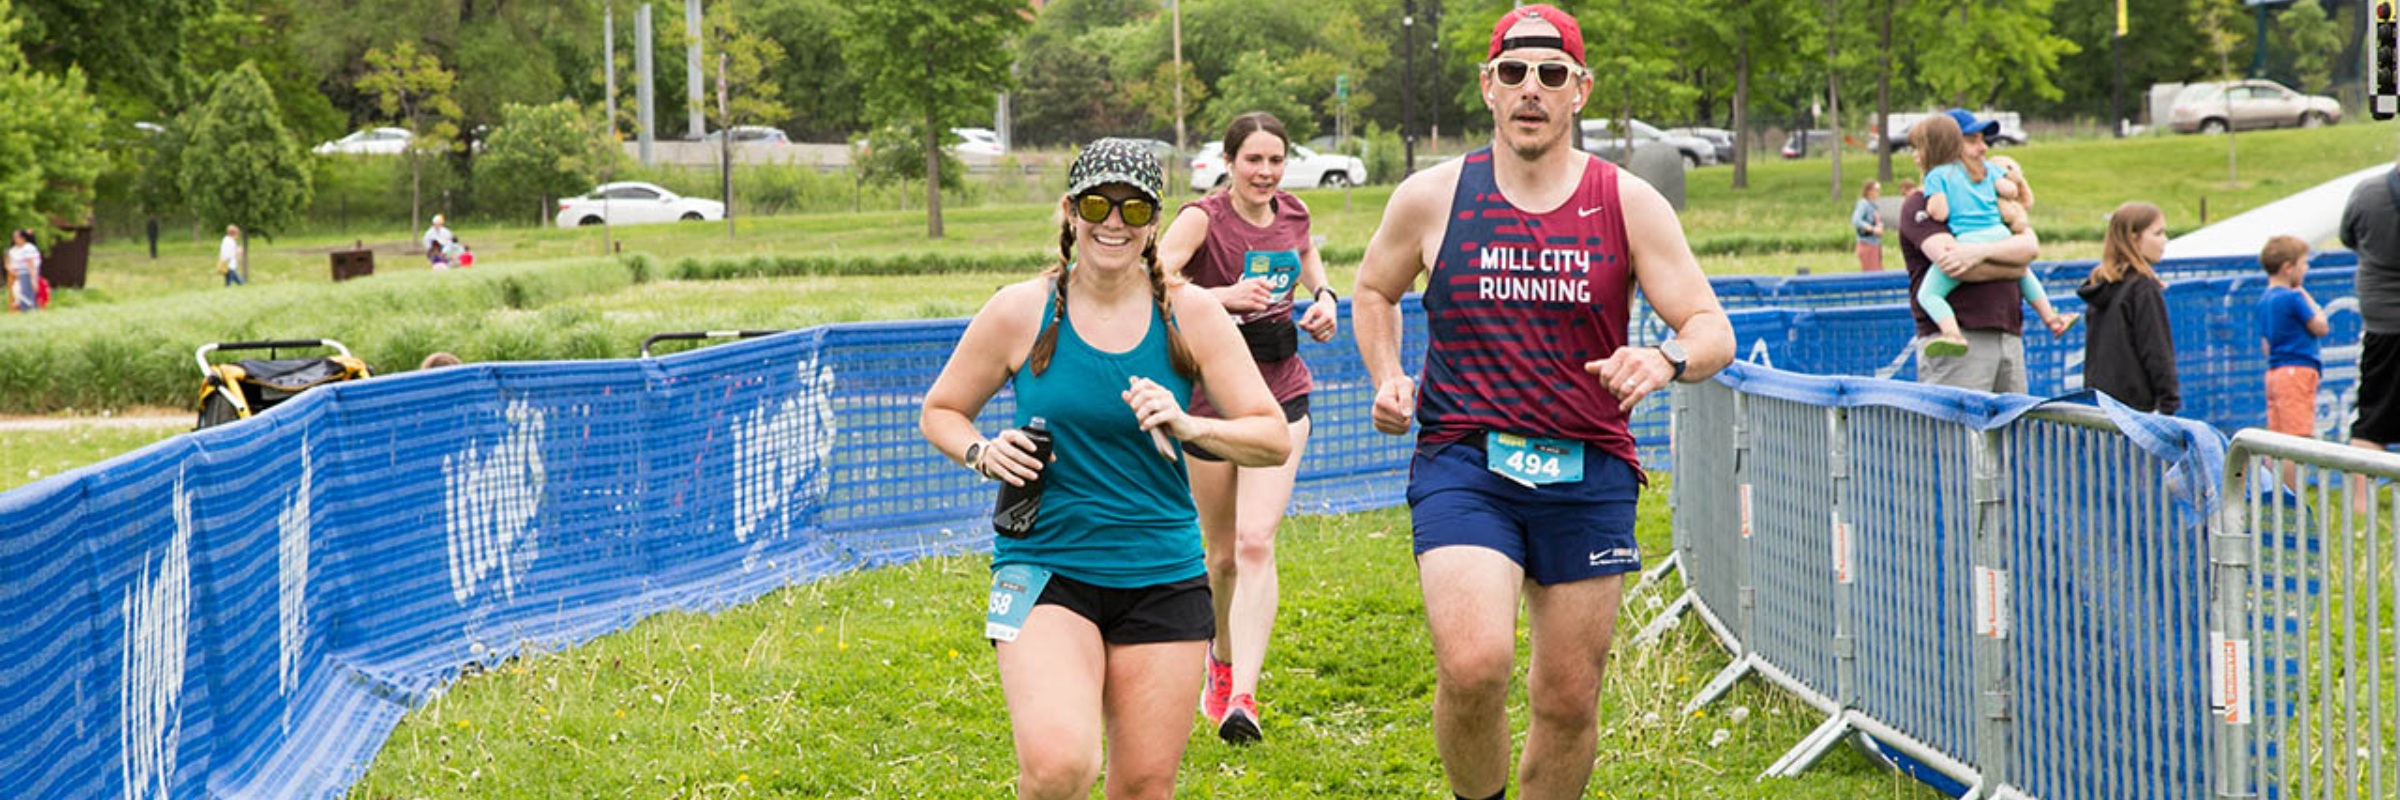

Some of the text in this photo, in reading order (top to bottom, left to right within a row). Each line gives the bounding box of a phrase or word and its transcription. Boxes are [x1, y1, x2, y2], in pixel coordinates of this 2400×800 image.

[1480, 247, 1590, 273] MILL CITY
[1479, 276, 1591, 303] RUNNING
[1505, 450, 1561, 478] 494
